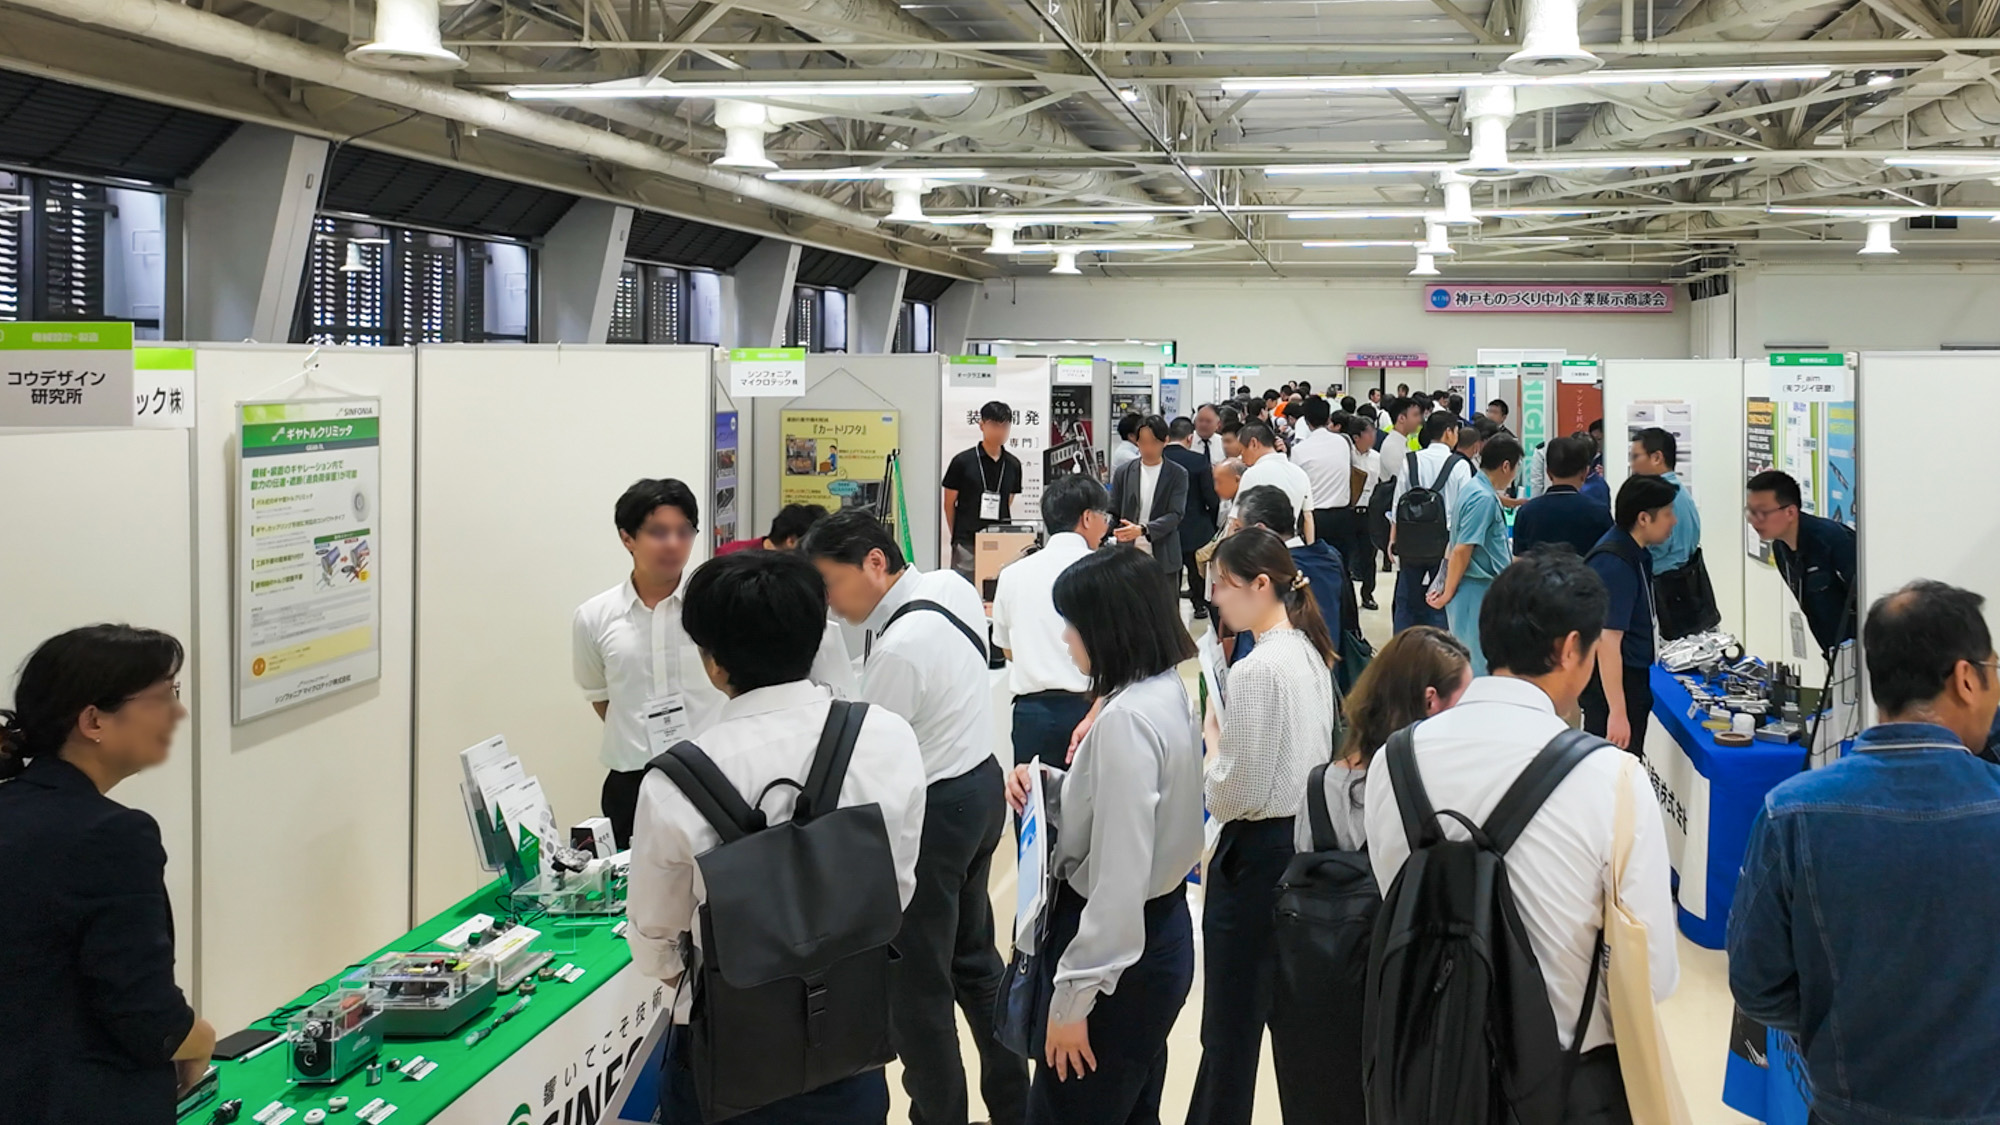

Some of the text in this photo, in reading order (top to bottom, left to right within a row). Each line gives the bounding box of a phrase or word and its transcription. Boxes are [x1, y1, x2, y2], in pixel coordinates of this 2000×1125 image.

[1455, 290, 1667, 307] 神戸ものづくり中小企業展示商談会
[8, 370, 106, 387] コウデザイン
[747, 370, 792, 378] シンフォニア
[31, 388, 82, 405] 研究所
[344, 407, 373, 416] SINFONIA
